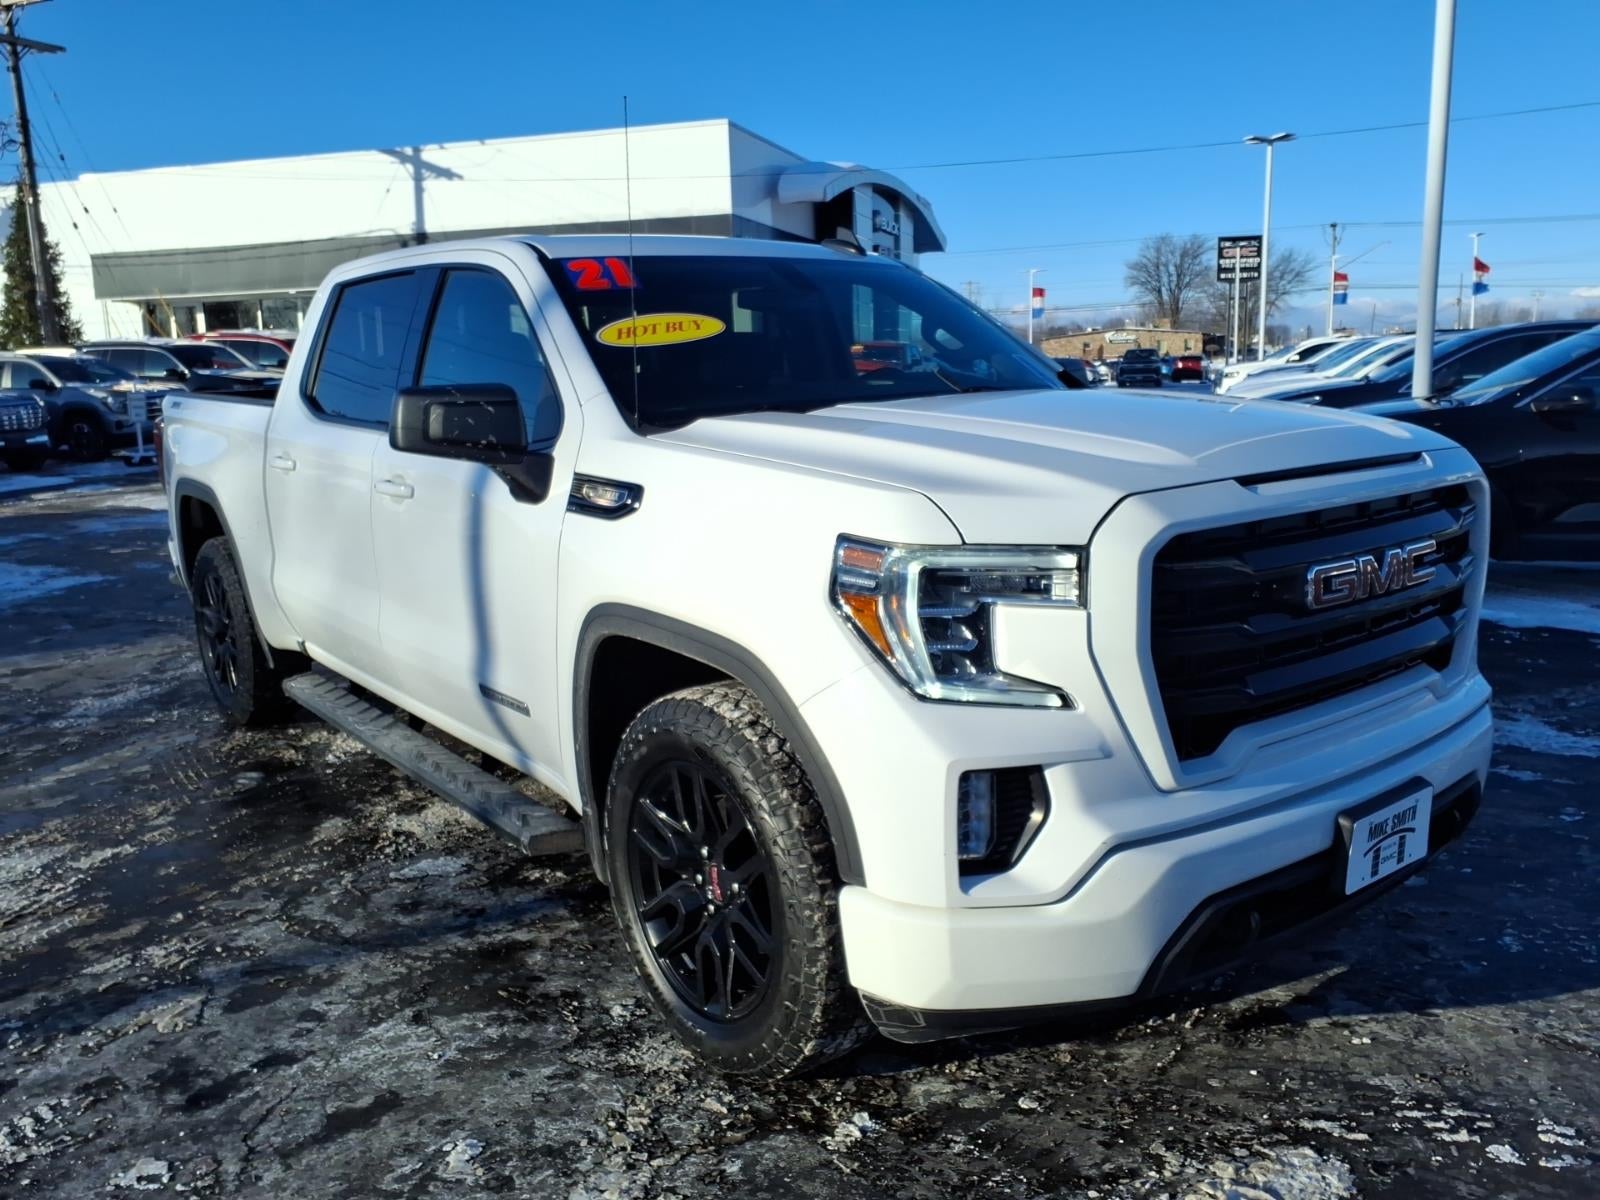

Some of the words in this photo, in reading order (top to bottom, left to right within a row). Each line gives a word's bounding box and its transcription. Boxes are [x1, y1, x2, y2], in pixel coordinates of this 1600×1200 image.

[567, 257, 637, 290] 21
[616, 322, 662, 340] HOT
[665, 319, 705, 335] BUY
[1307, 540, 1436, 609] GMC
[1368, 817, 1390, 843] MIKE
[1391, 804, 1418, 832] SMITH
